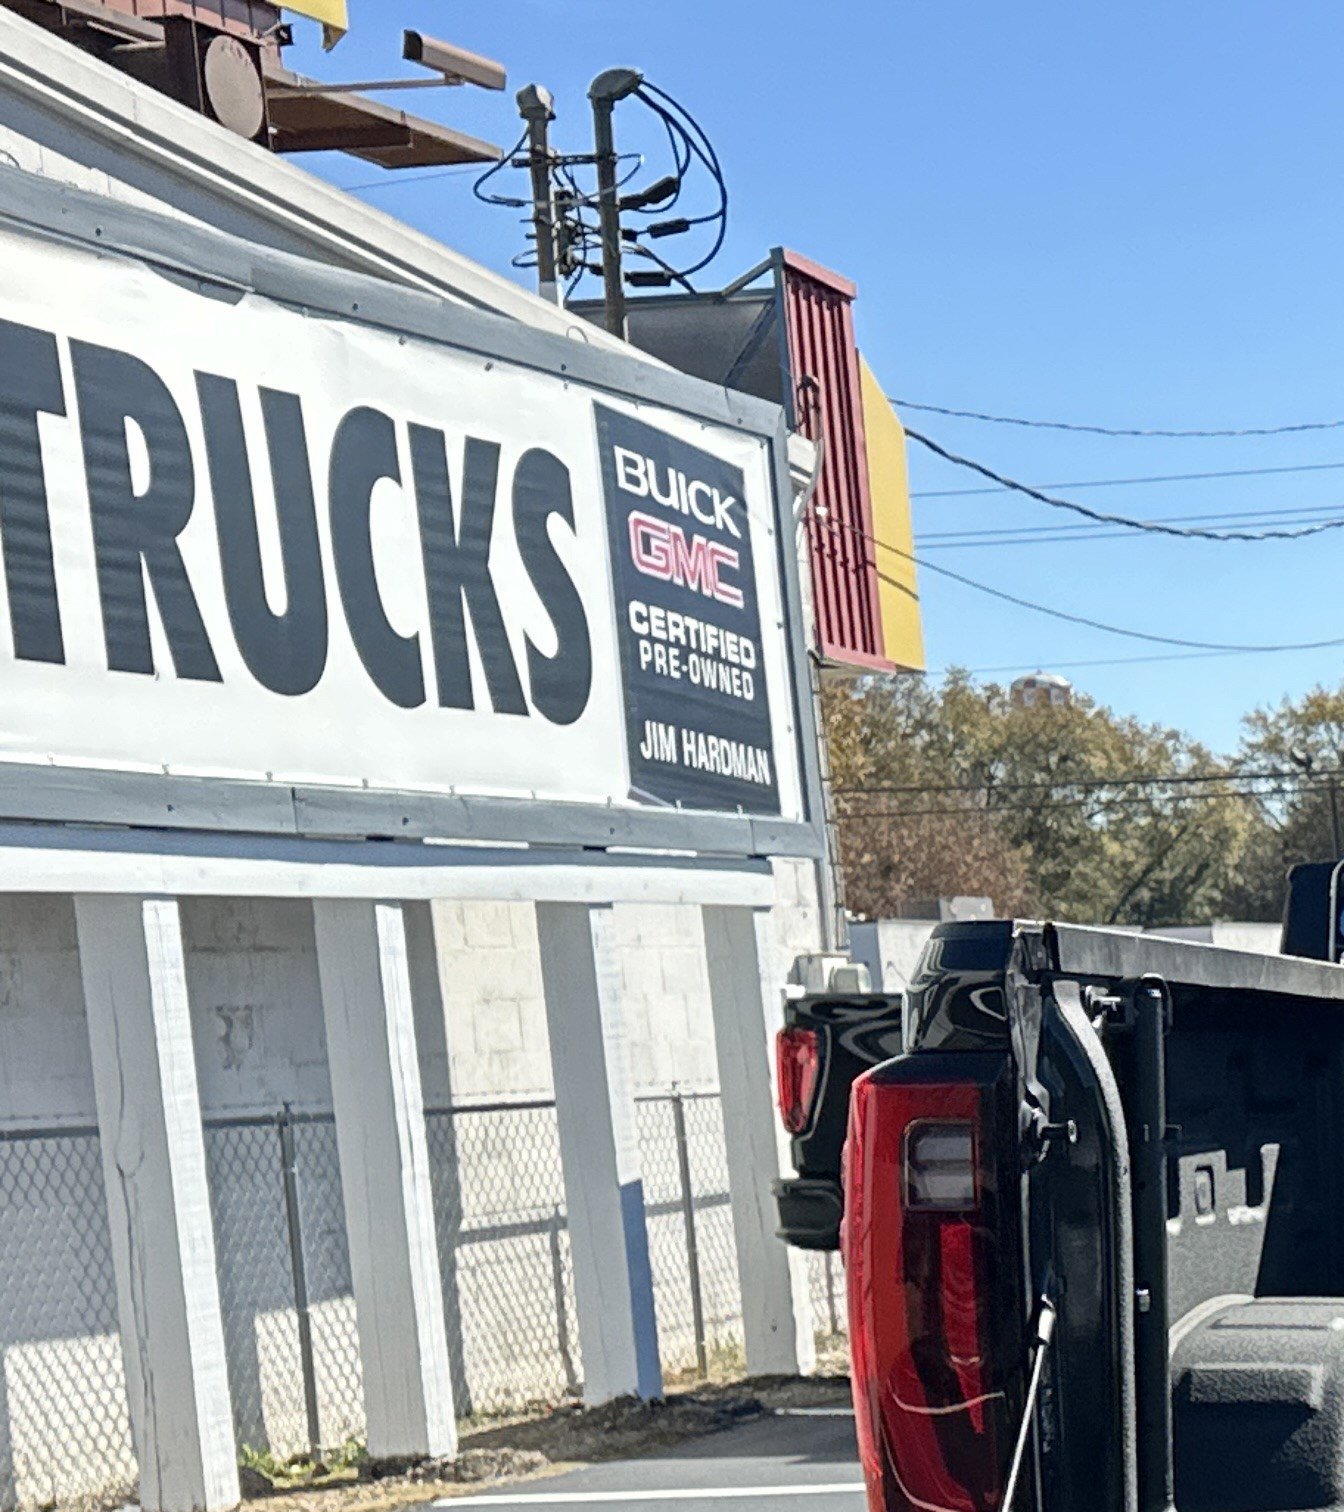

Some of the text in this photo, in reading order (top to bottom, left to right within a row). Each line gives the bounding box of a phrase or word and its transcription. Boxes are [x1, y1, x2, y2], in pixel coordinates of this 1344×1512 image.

[0, 317, 593, 727] TRUCKS
[613, 444, 742, 539] BUICK
[627, 509, 745, 609] GMC
[628, 599, 756, 669] CERTIFIED
[639, 639, 755, 701] PRE-OWNED
[640, 720, 772, 786] JIM HARDMAN
